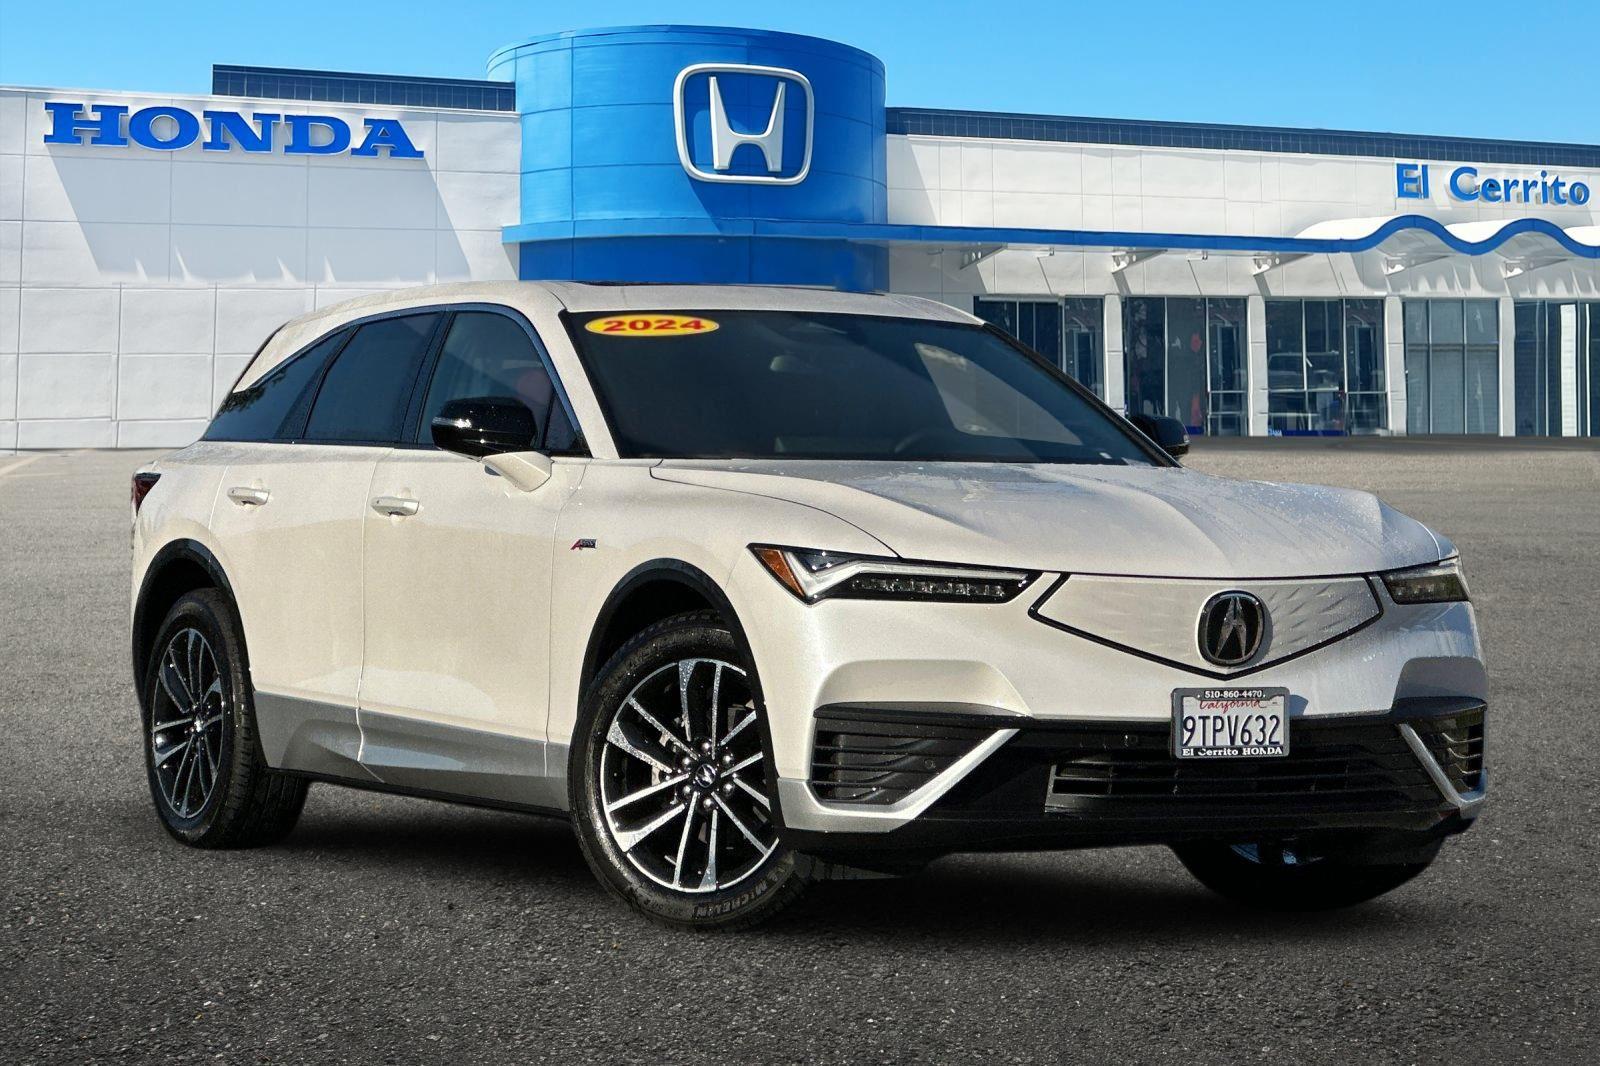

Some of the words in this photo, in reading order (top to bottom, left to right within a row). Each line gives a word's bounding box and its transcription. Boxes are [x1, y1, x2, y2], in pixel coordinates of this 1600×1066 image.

[44, 101, 425, 158] HONDA
[1396, 163, 1430, 199] El
[1449, 166, 1590, 206] Cerrito
[603, 319, 705, 332] 2024
[1204, 690, 1262, 698] 510-860-4470
[1183, 715, 1280, 747] 9TPV632
[1182, 747, 1194, 756] El
